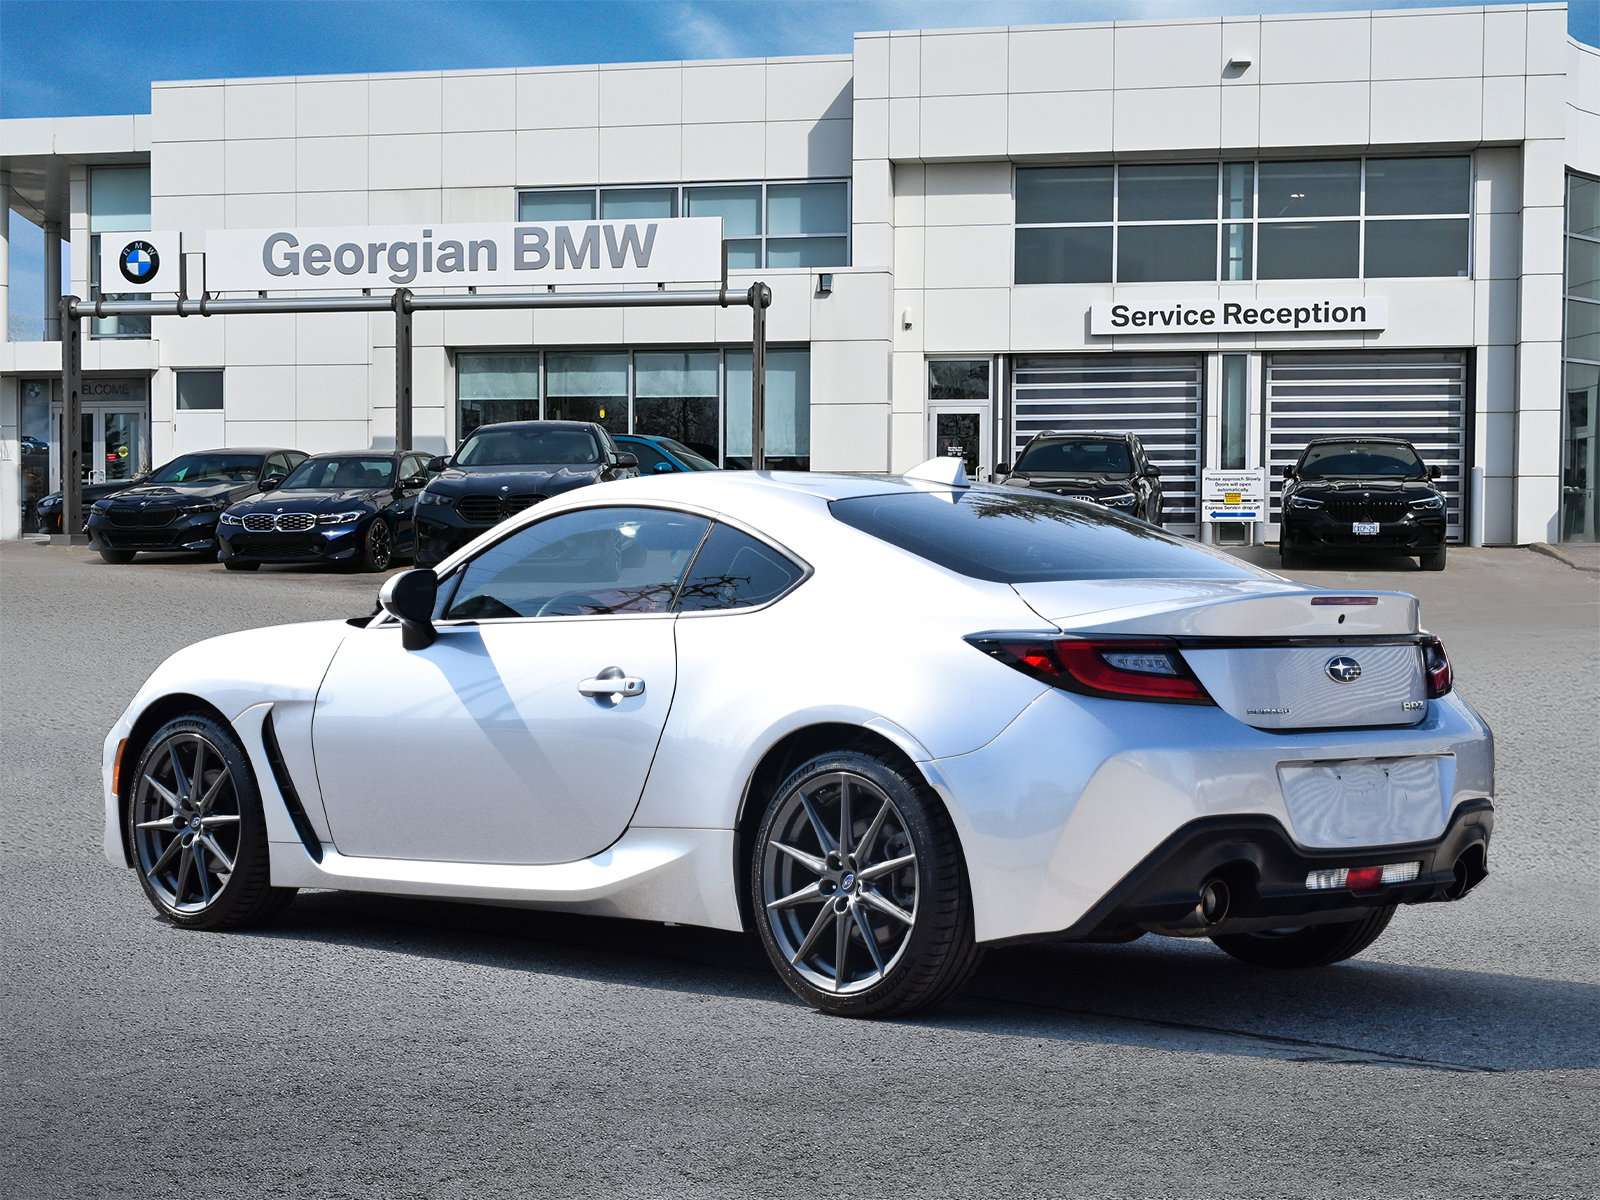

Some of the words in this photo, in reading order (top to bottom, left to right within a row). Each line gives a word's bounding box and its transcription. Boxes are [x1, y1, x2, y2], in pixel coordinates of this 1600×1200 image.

[262, 228, 498, 285] Georgian
[513, 223, 659, 271] BMW
[1111, 303, 1216, 328] Service
[1223, 301, 1367, 328] Reception
[81, 383, 129, 395] ELCOME
[1401, 700, 1425, 712] BRZ
